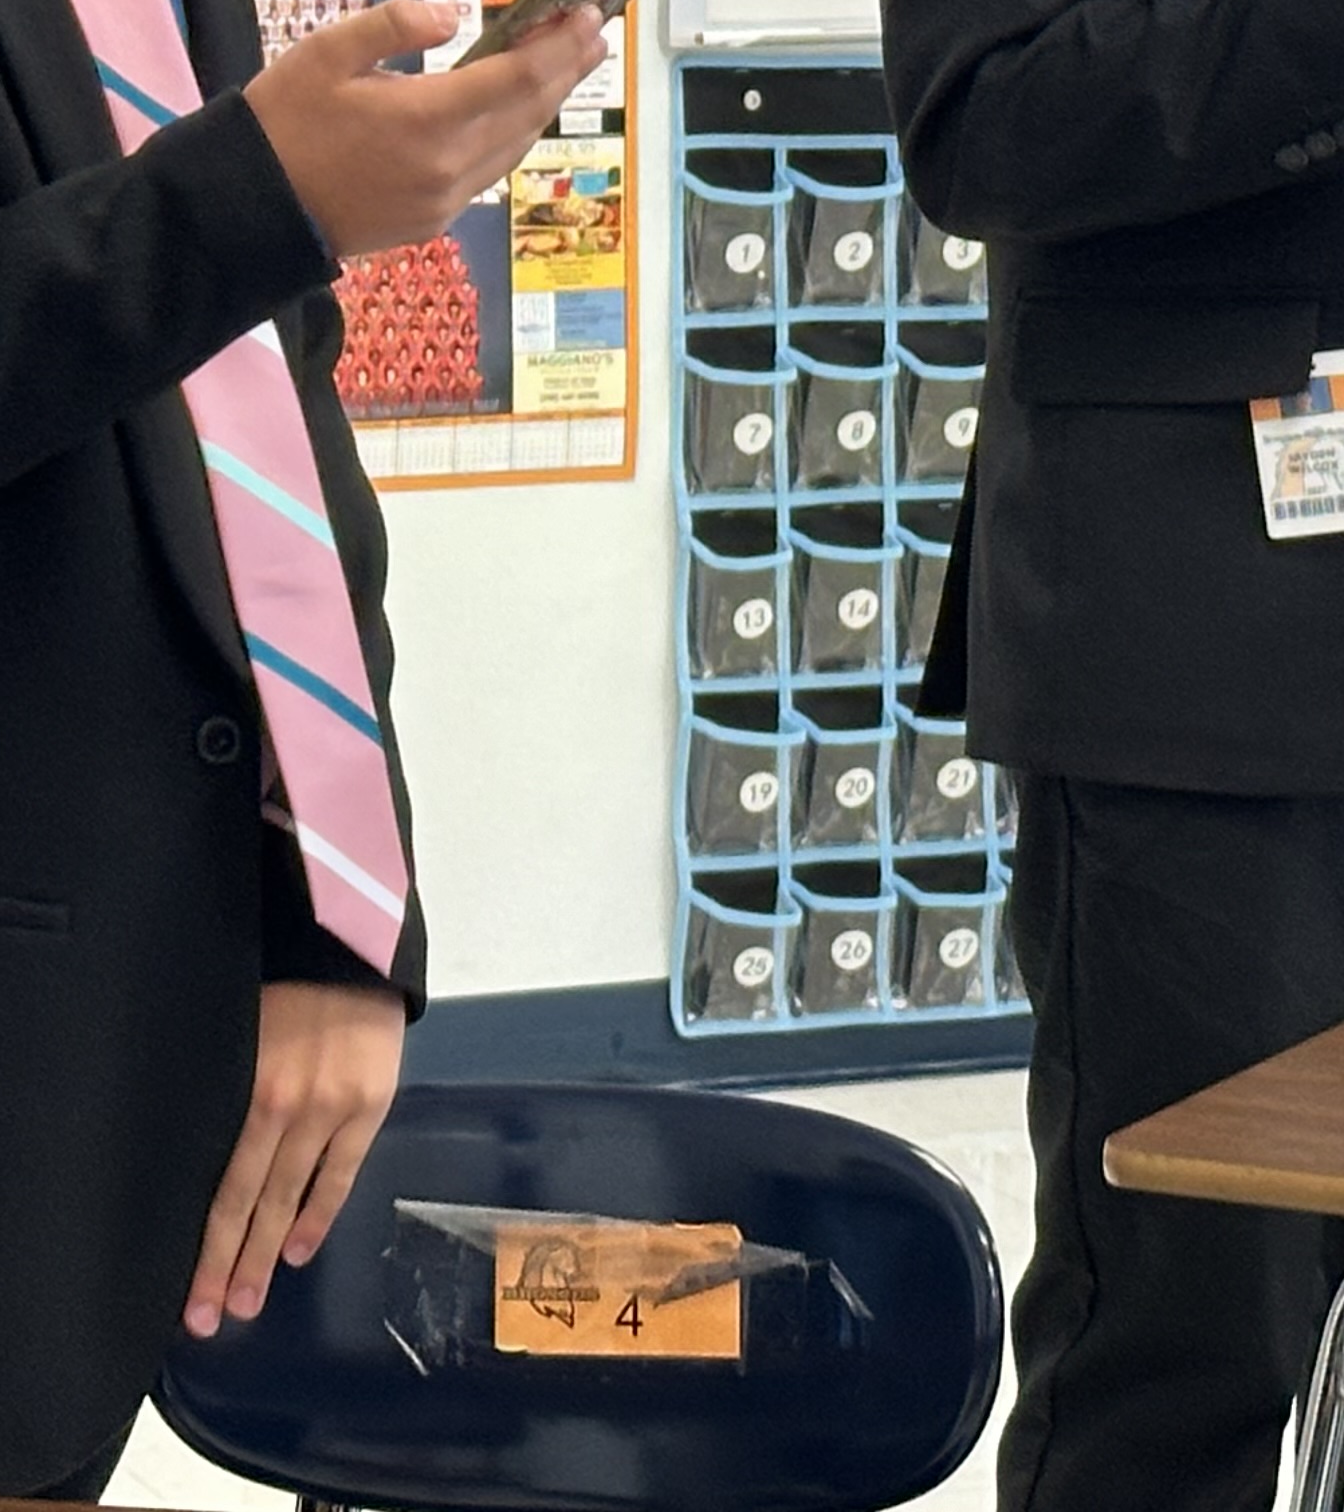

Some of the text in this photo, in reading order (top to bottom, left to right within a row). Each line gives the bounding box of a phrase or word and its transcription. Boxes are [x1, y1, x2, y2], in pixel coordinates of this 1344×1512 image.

[741, 243, 752, 265] 1
[848, 241, 861, 263] 2
[956, 241, 969, 260] 3
[747, 422, 763, 445] 7
[850, 420, 865, 442] 8
[957, 417, 971, 438] 9
[741, 607, 766, 630] 13
[846, 598, 871, 621] 14
[842, 775, 869, 799] 20
[944, 767, 972, 789] 21
[747, 780, 773, 804] 19
[840, 940, 866, 962] 26
[945, 937, 974, 961] 27
[741, 956, 768, 979] 25
[614, 1293, 644, 1336] 4
